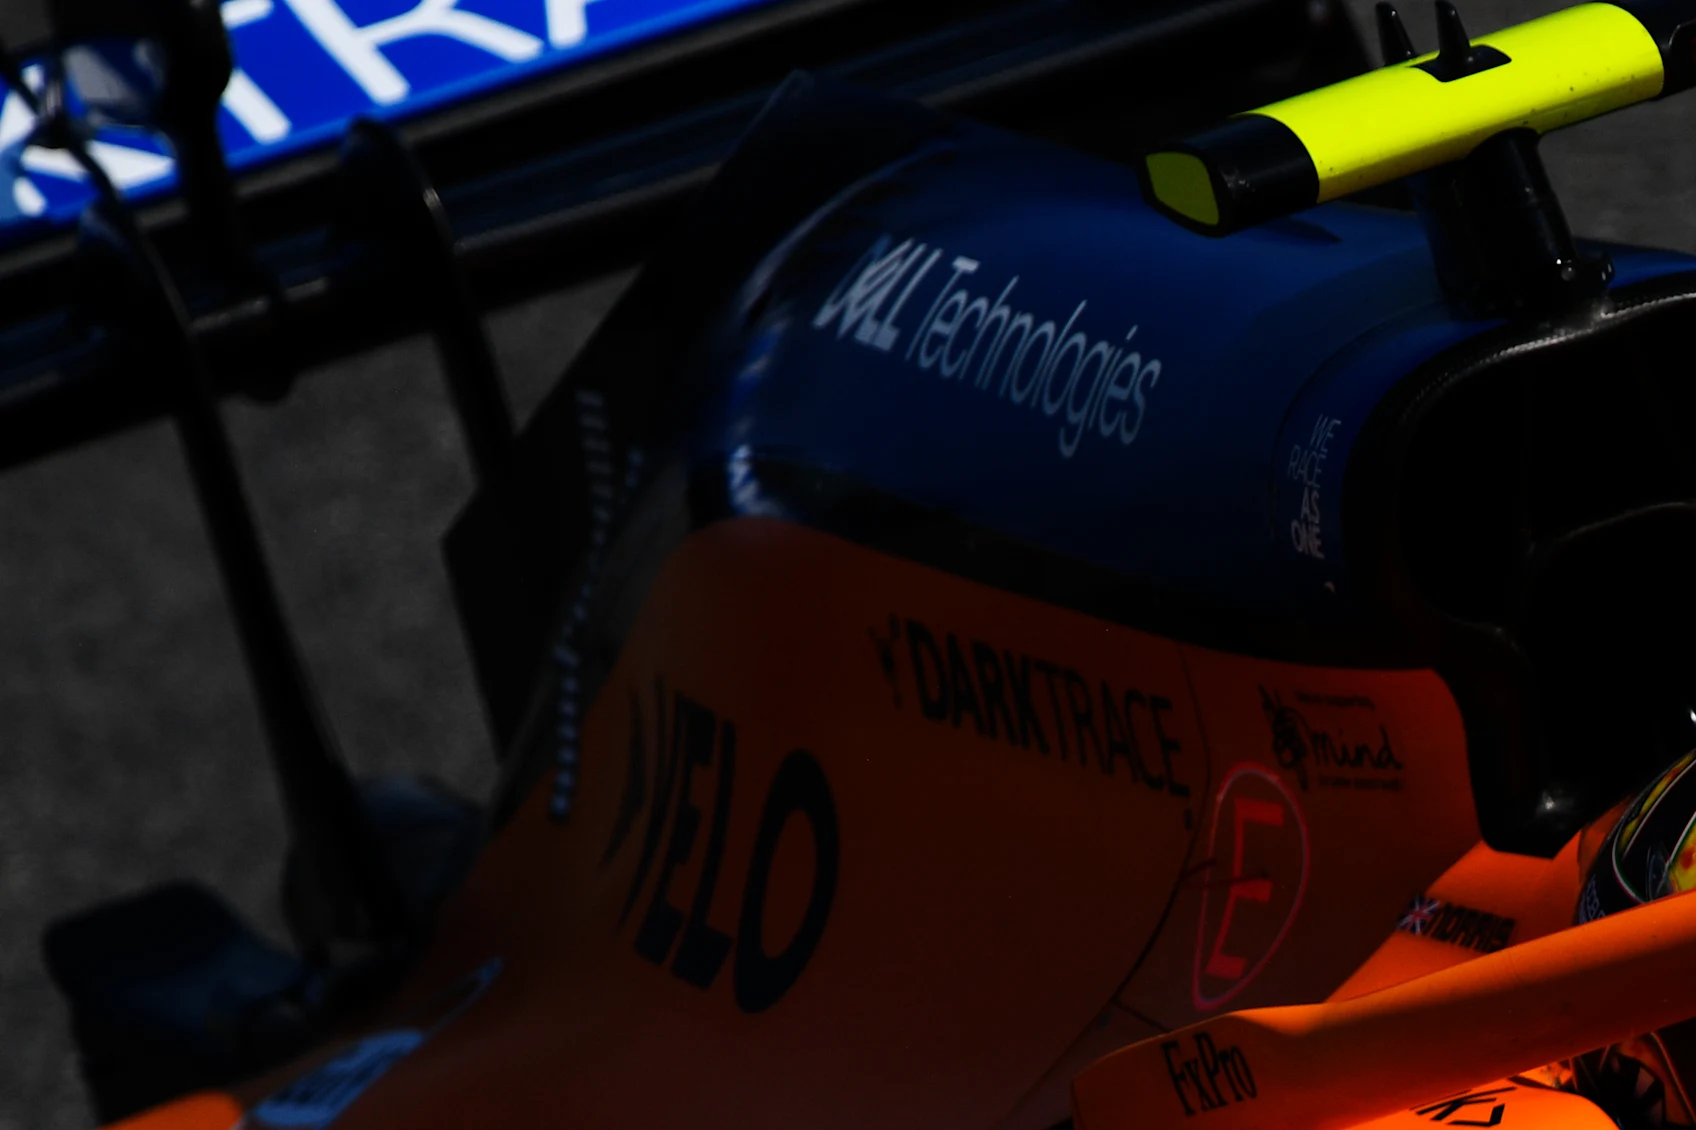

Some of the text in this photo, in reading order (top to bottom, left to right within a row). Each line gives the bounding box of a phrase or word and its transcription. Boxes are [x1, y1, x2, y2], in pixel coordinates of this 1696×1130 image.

[903, 254, 1163, 460] Technologies
[905, 618, 1190, 796] DARKTRACE
[614, 672, 839, 1013] VELO
[1160, 1032, 1257, 1117] FxPro
